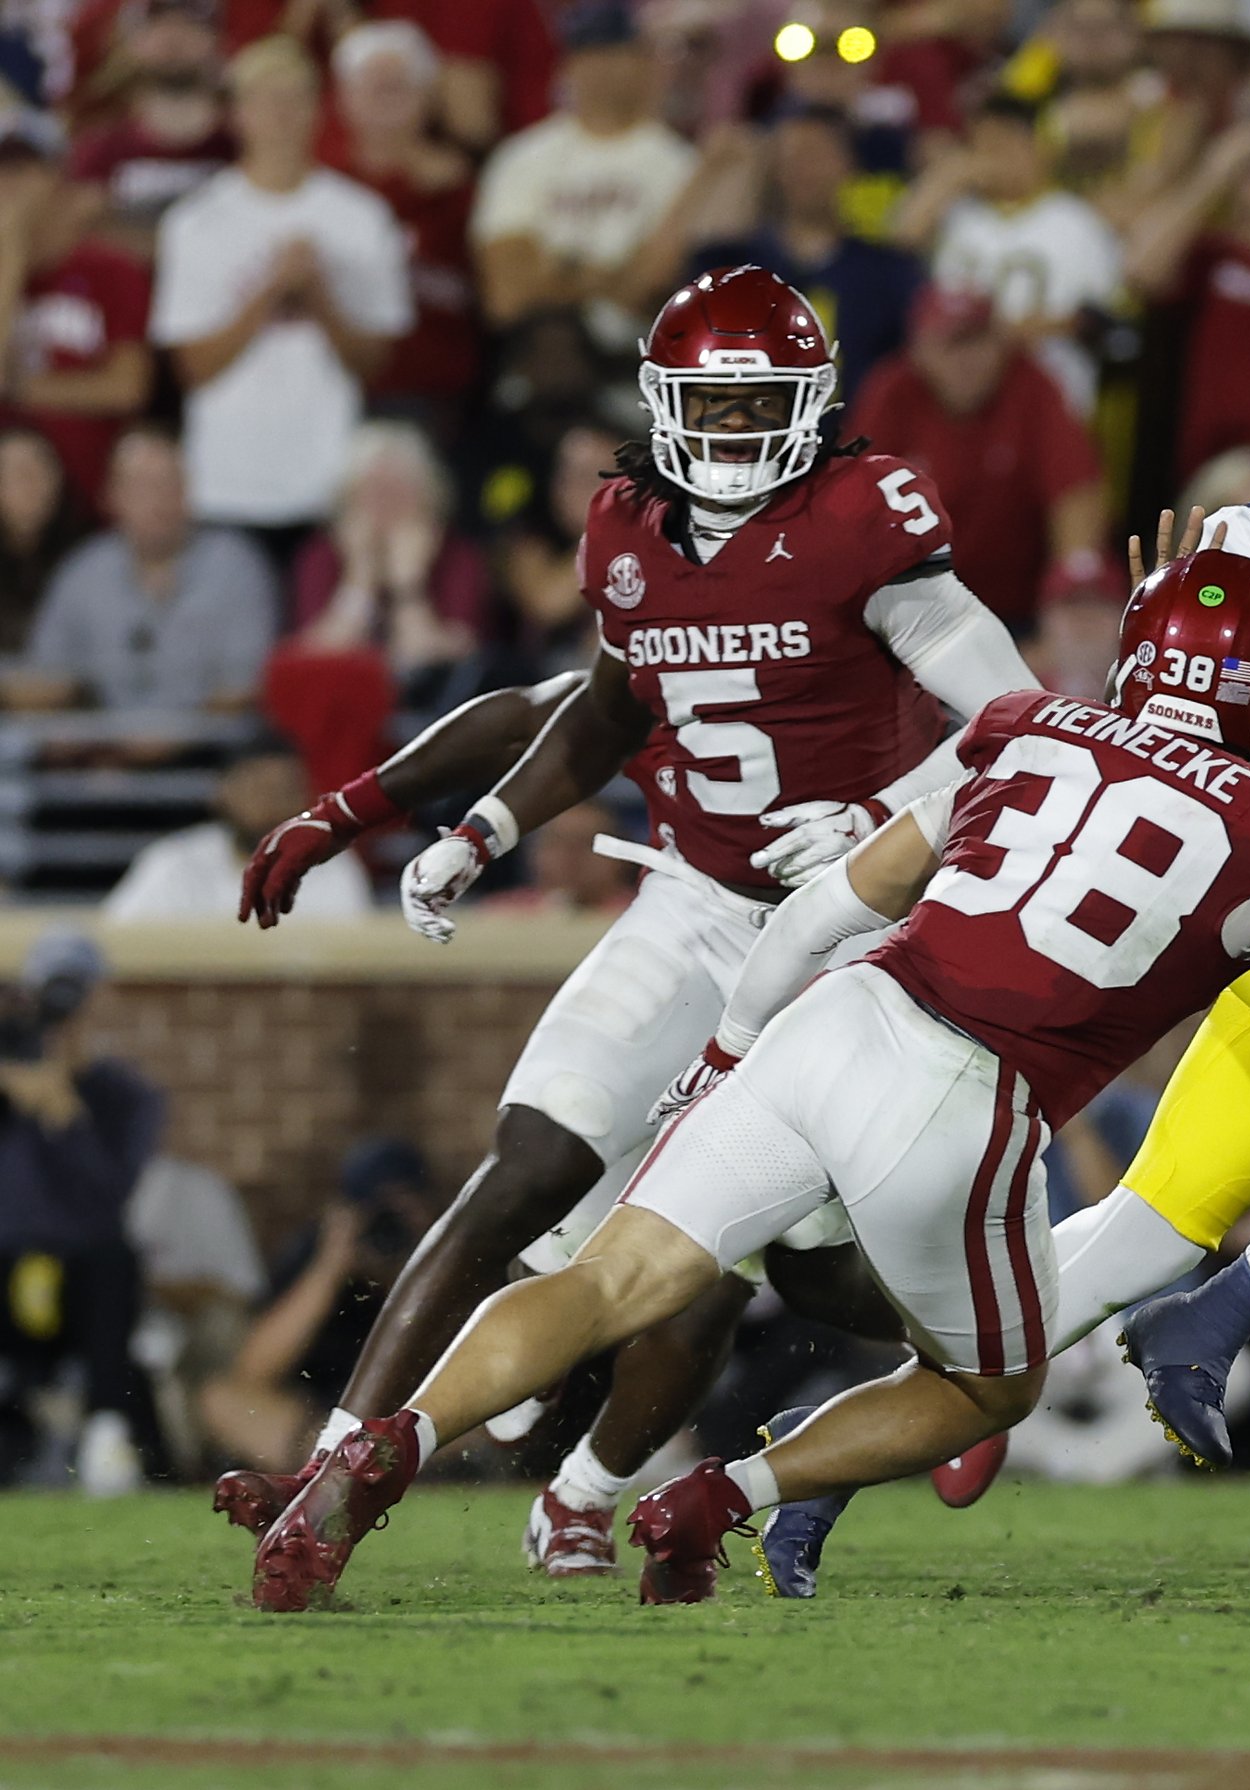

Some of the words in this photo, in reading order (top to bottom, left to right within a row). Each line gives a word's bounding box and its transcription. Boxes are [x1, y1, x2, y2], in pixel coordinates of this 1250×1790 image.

[876, 468, 939, 536] 5
[1201, 589, 1222, 601] C2P
[628, 621, 811, 667] SOONERS
[1160, 647, 1215, 693] 38
[1147, 703, 1214, 730] SOONERS
[657, 667, 781, 816] 5
[917, 733, 1233, 990] 38
